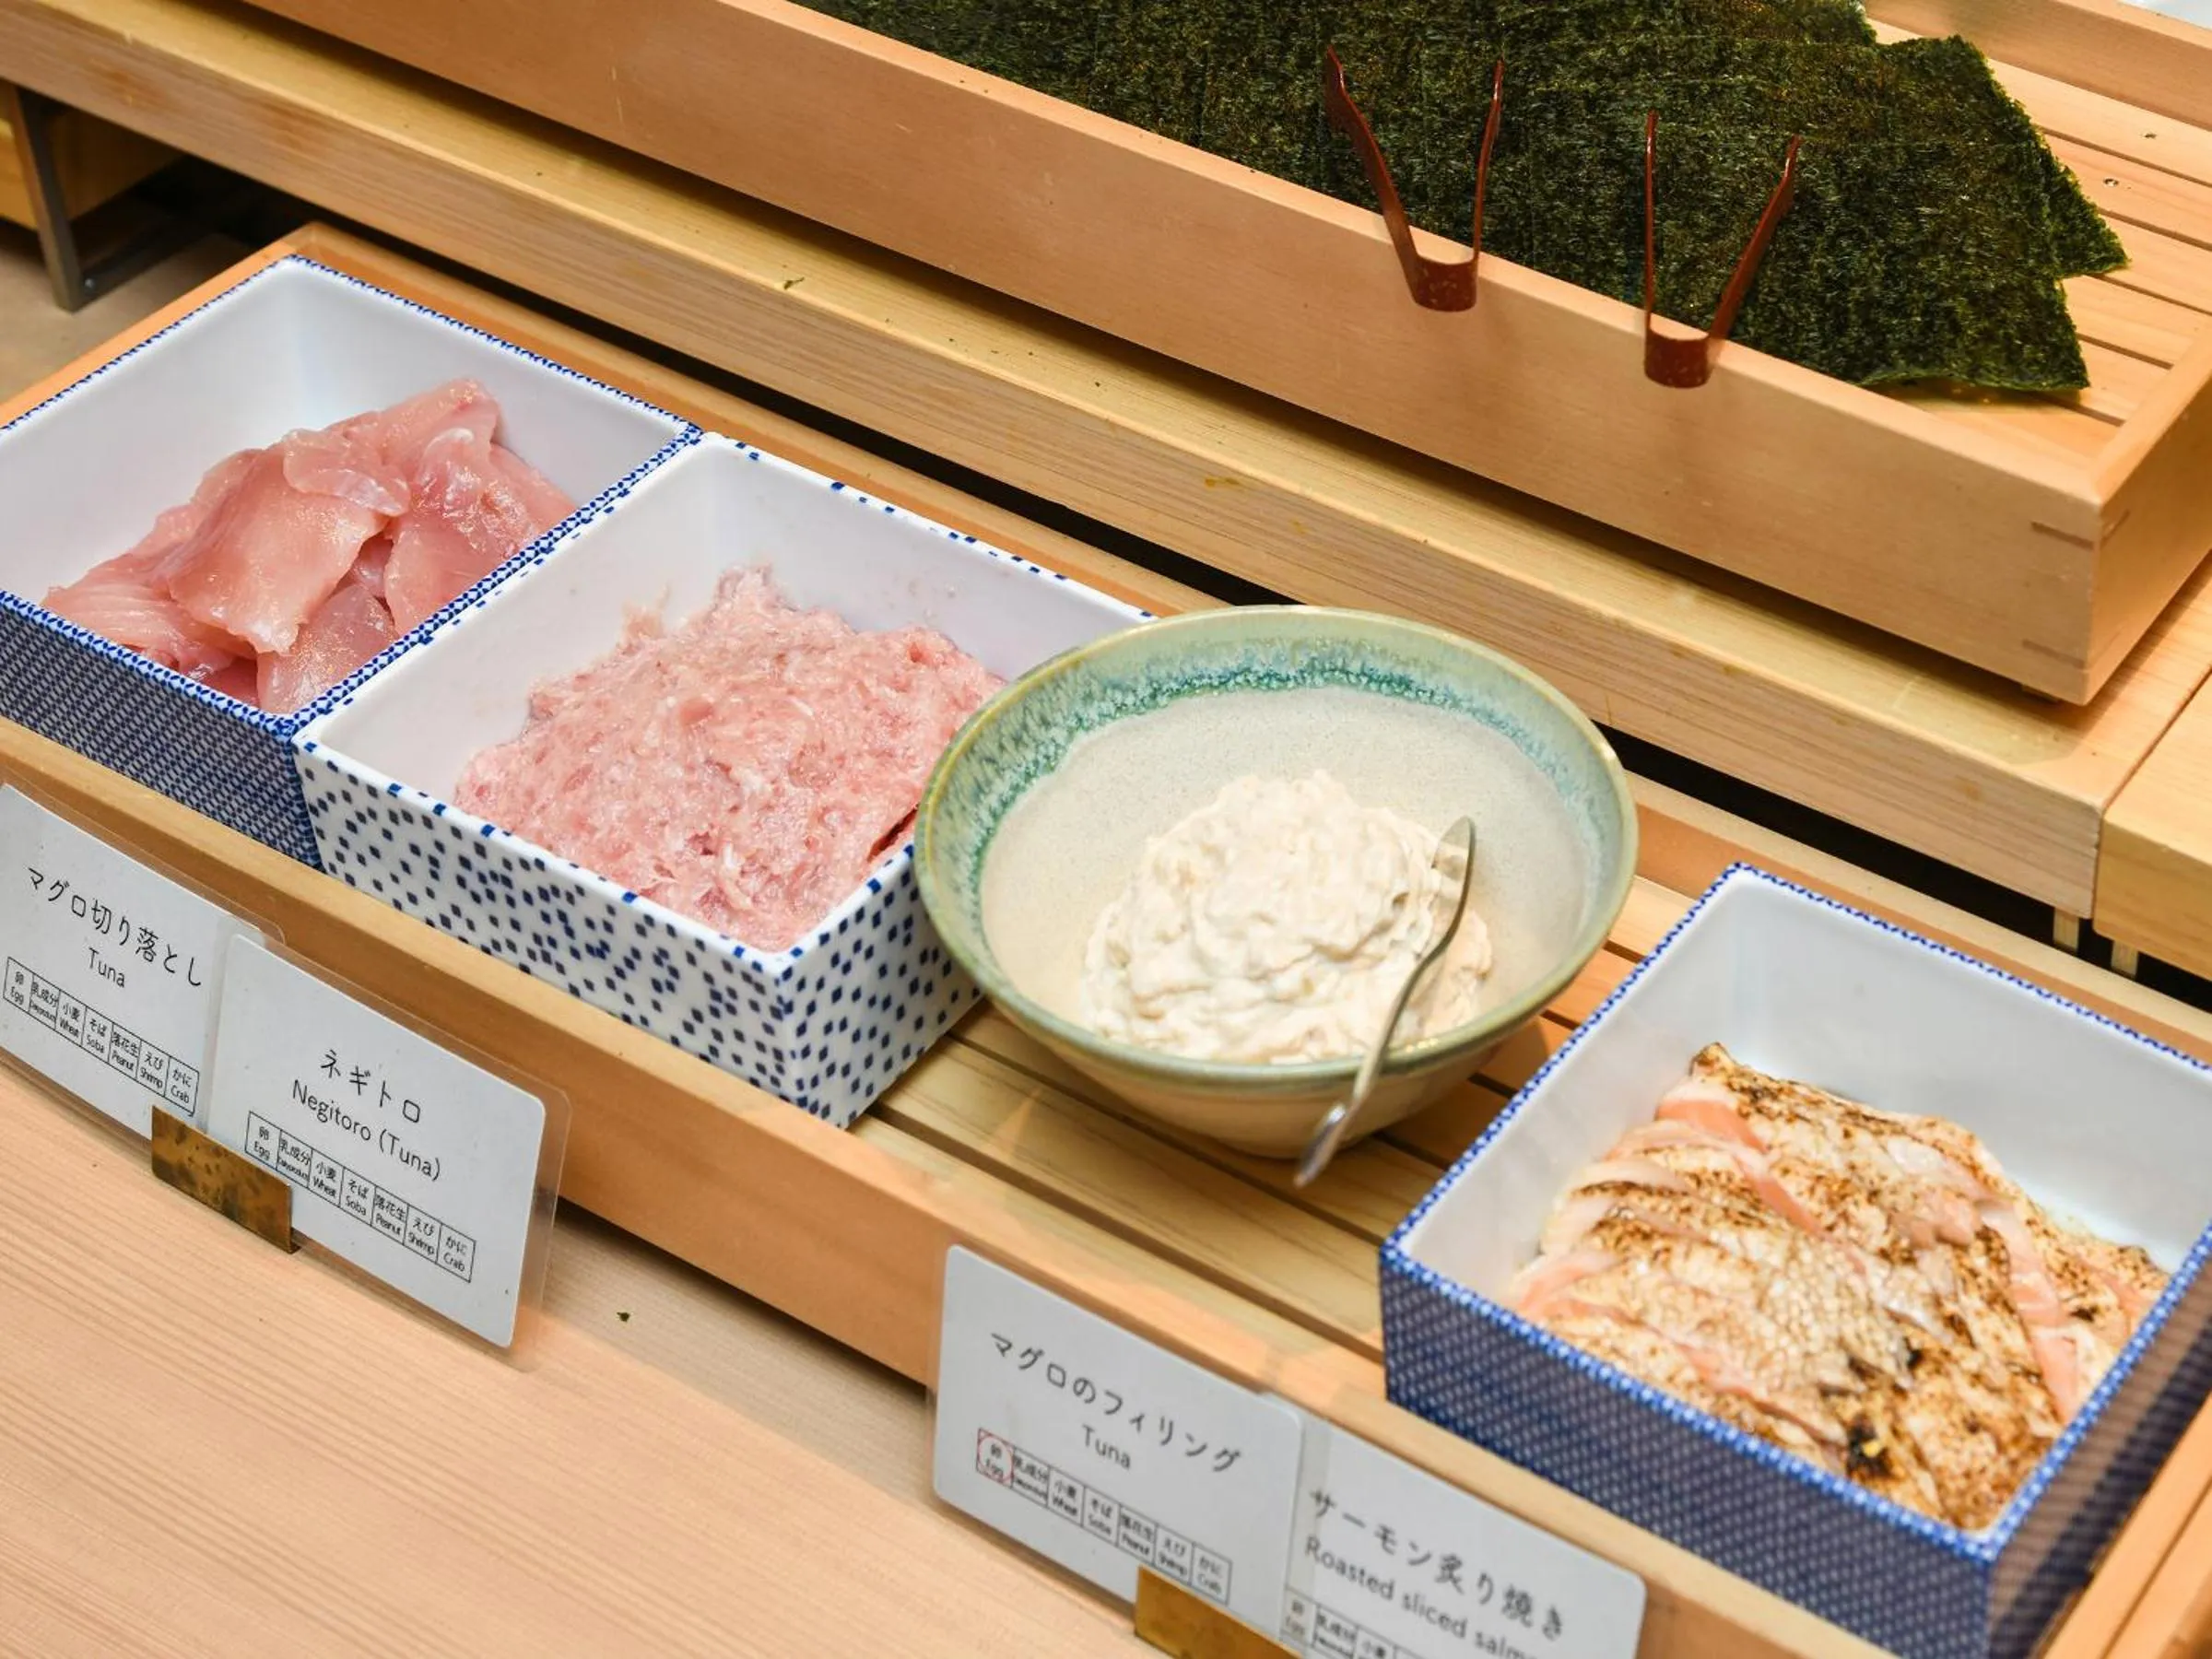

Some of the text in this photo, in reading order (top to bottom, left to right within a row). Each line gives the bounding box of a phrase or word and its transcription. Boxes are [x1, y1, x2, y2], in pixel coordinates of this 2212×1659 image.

[28, 866, 202, 987] マグロ切り落とし
[88, 947, 125, 988] Tuna
[145, 1051, 164, 1070] えび
[171, 1085, 190, 1103] Crab
[321, 1049, 421, 1124] ネギトロ
[292, 1079, 441, 1182] Negitoro (Tuna)
[345, 1195, 366, 1216] Soba
[443, 1252, 465, 1272] Crab
[348, 1179, 369, 1199] そば
[413, 1217, 434, 1236] えび
[991, 1332, 1241, 1472] マグロのフィリング
[1081, 1424, 1131, 1470] Tuna
[1305, 1535, 1395, 1602] Roasted
[1402, 1590, 1468, 1640] sliced
[1475, 1630, 1537, 1659] salm
[1309, 1488, 1564, 1641] サーモン炙り焼き
